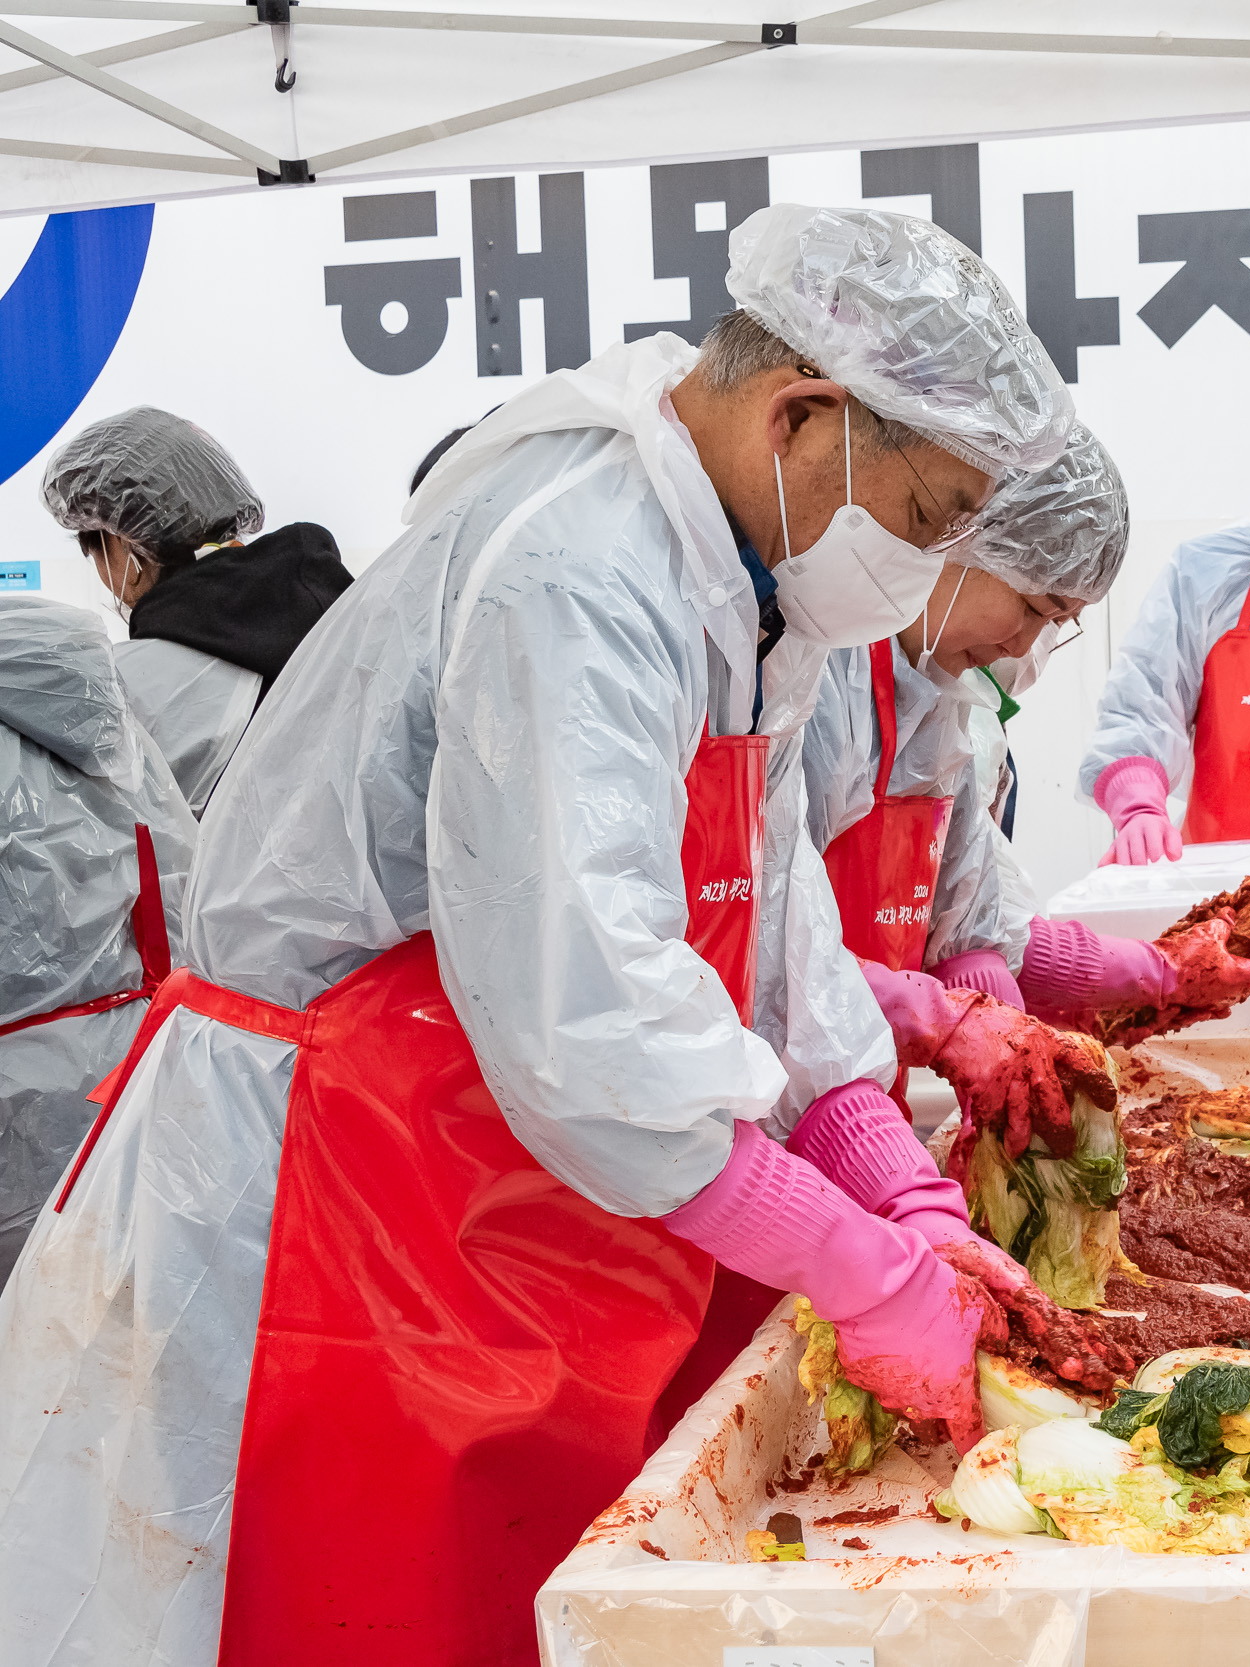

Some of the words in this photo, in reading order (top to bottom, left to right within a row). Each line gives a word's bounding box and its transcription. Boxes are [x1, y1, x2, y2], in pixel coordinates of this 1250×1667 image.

[803, 368, 814, 376] FILA
[698, 878, 728, 903] 제2회
[729, 876, 751, 902] 광진
[913, 885, 929, 899] 2024
[874, 906, 897, 926] 제2회
[898, 905, 913, 926] 광진
